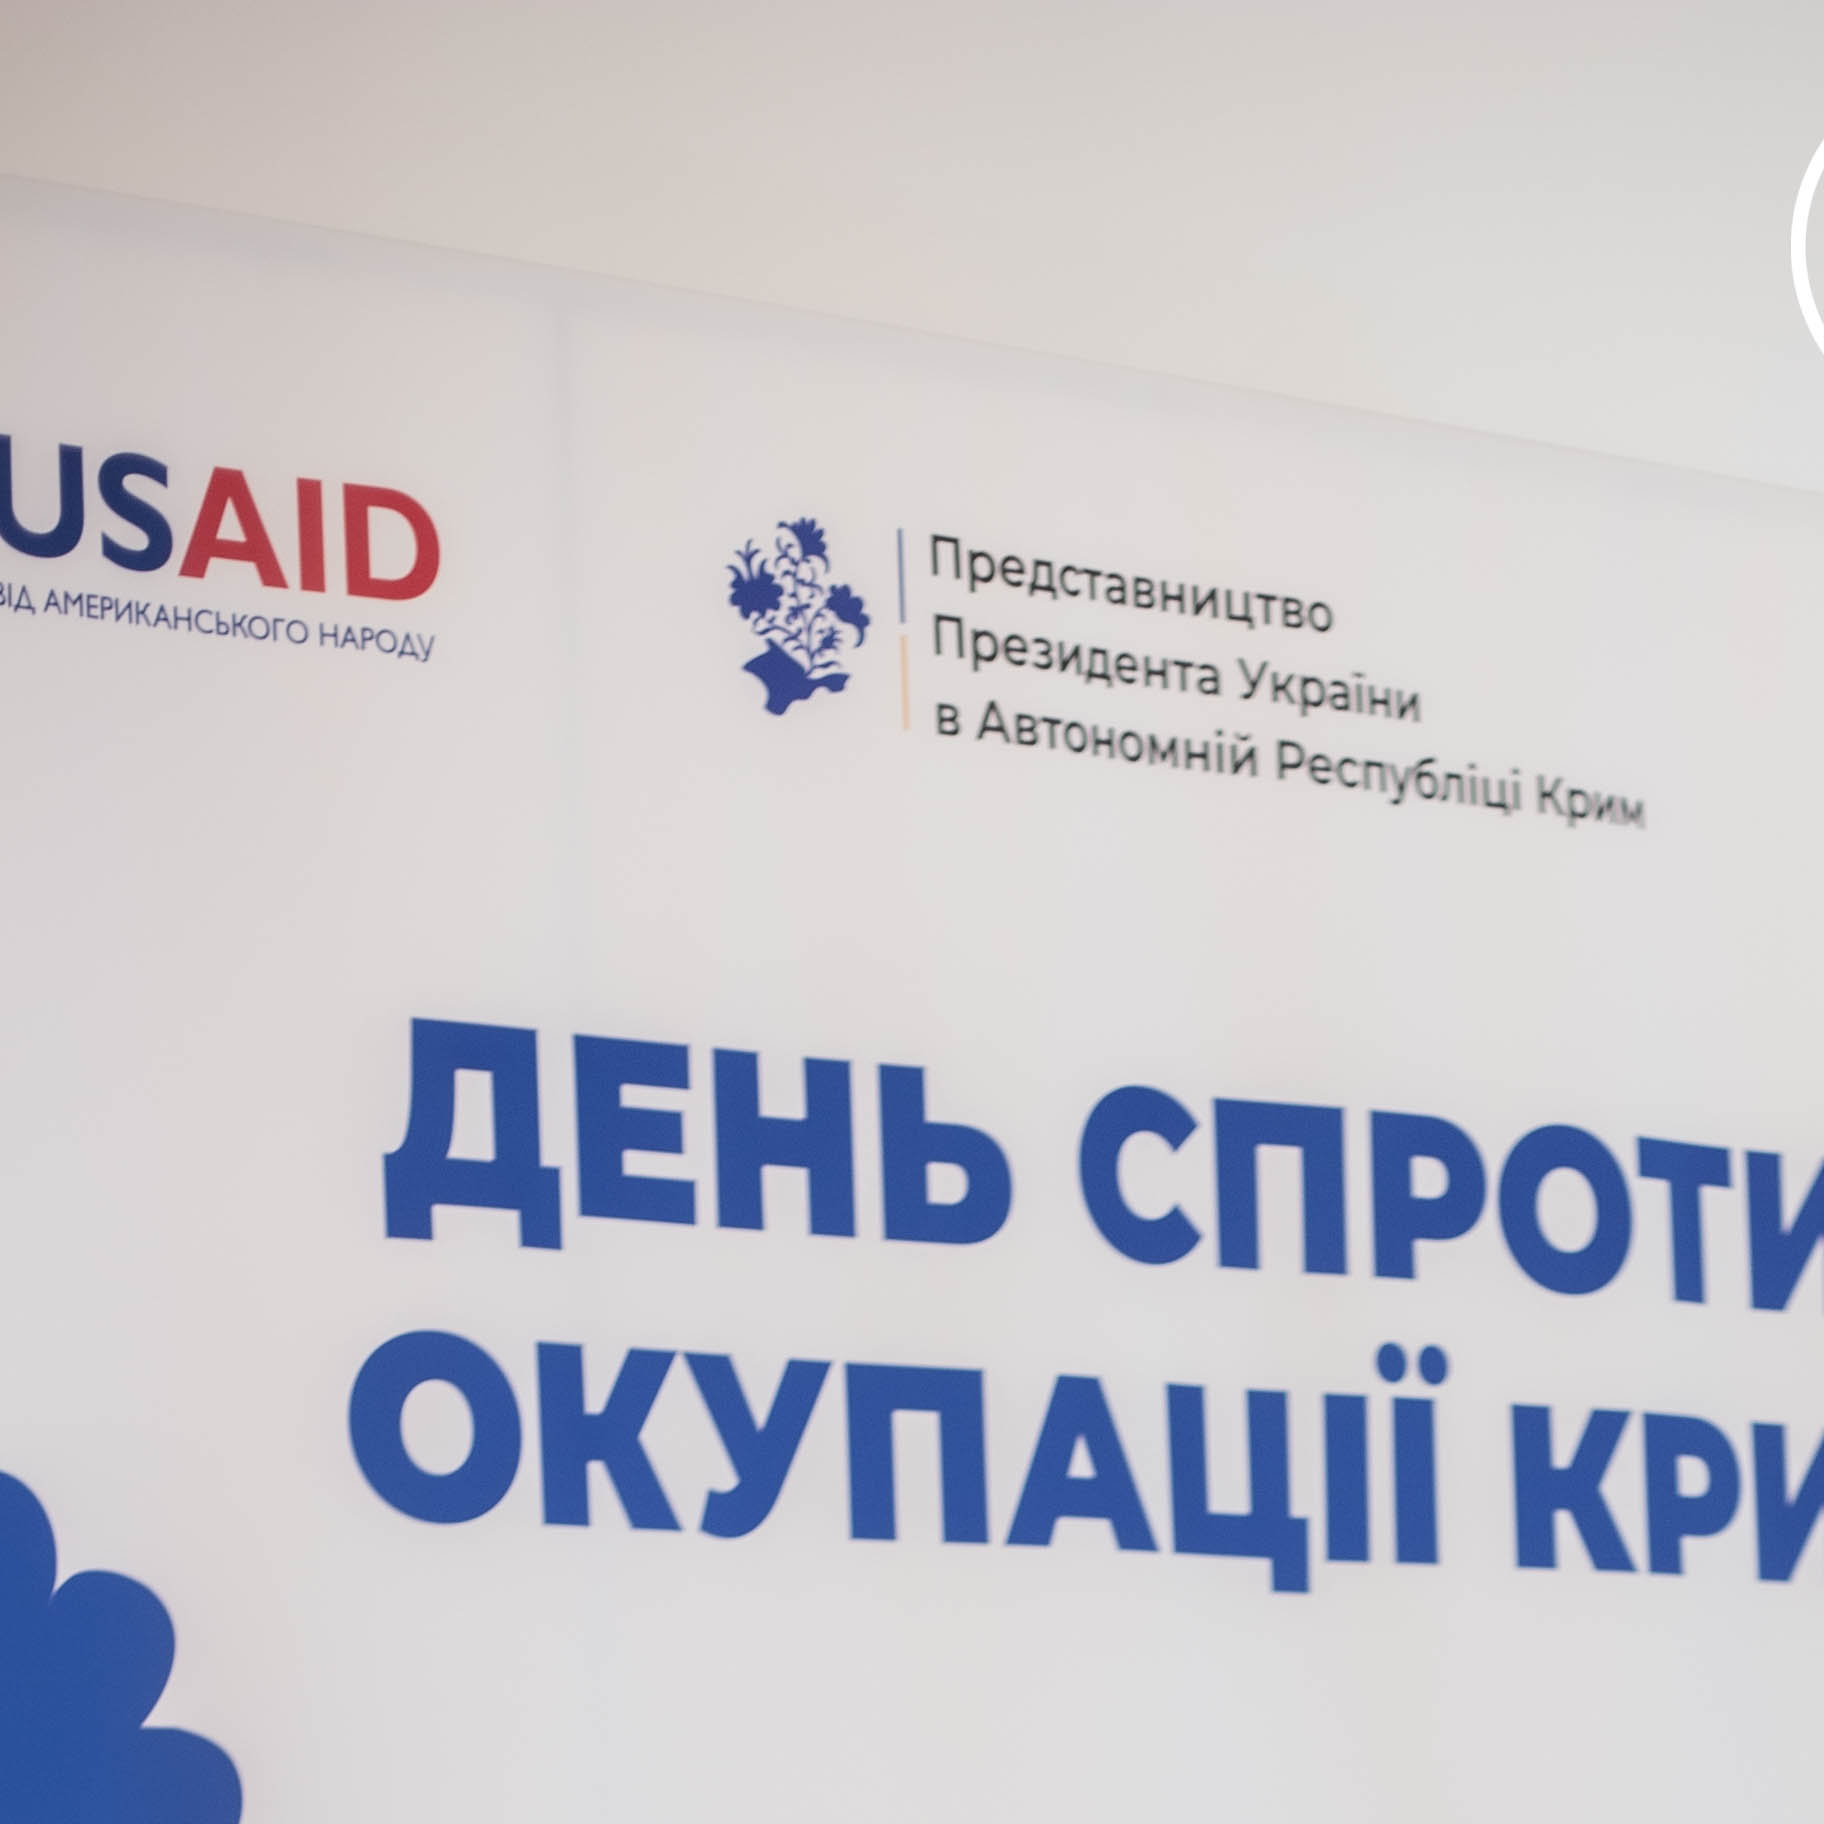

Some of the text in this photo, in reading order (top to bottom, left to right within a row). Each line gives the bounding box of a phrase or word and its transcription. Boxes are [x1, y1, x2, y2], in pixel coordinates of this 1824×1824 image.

[0, 434, 441, 601] USAID
[43, 587, 308, 647] АМЕРИКАНСЬКОГО
[319, 622, 436, 664] НАРОДУ
[929, 533, 1334, 635] Представництво
[932, 614, 1423, 724] Президента України
[935, 700, 1648, 832] в Автономній Республіці Крим
[382, 1017, 1014, 1252] ДЕНЬ
[347, 1329, 1449, 1595] ОКУПАЦІЇ
